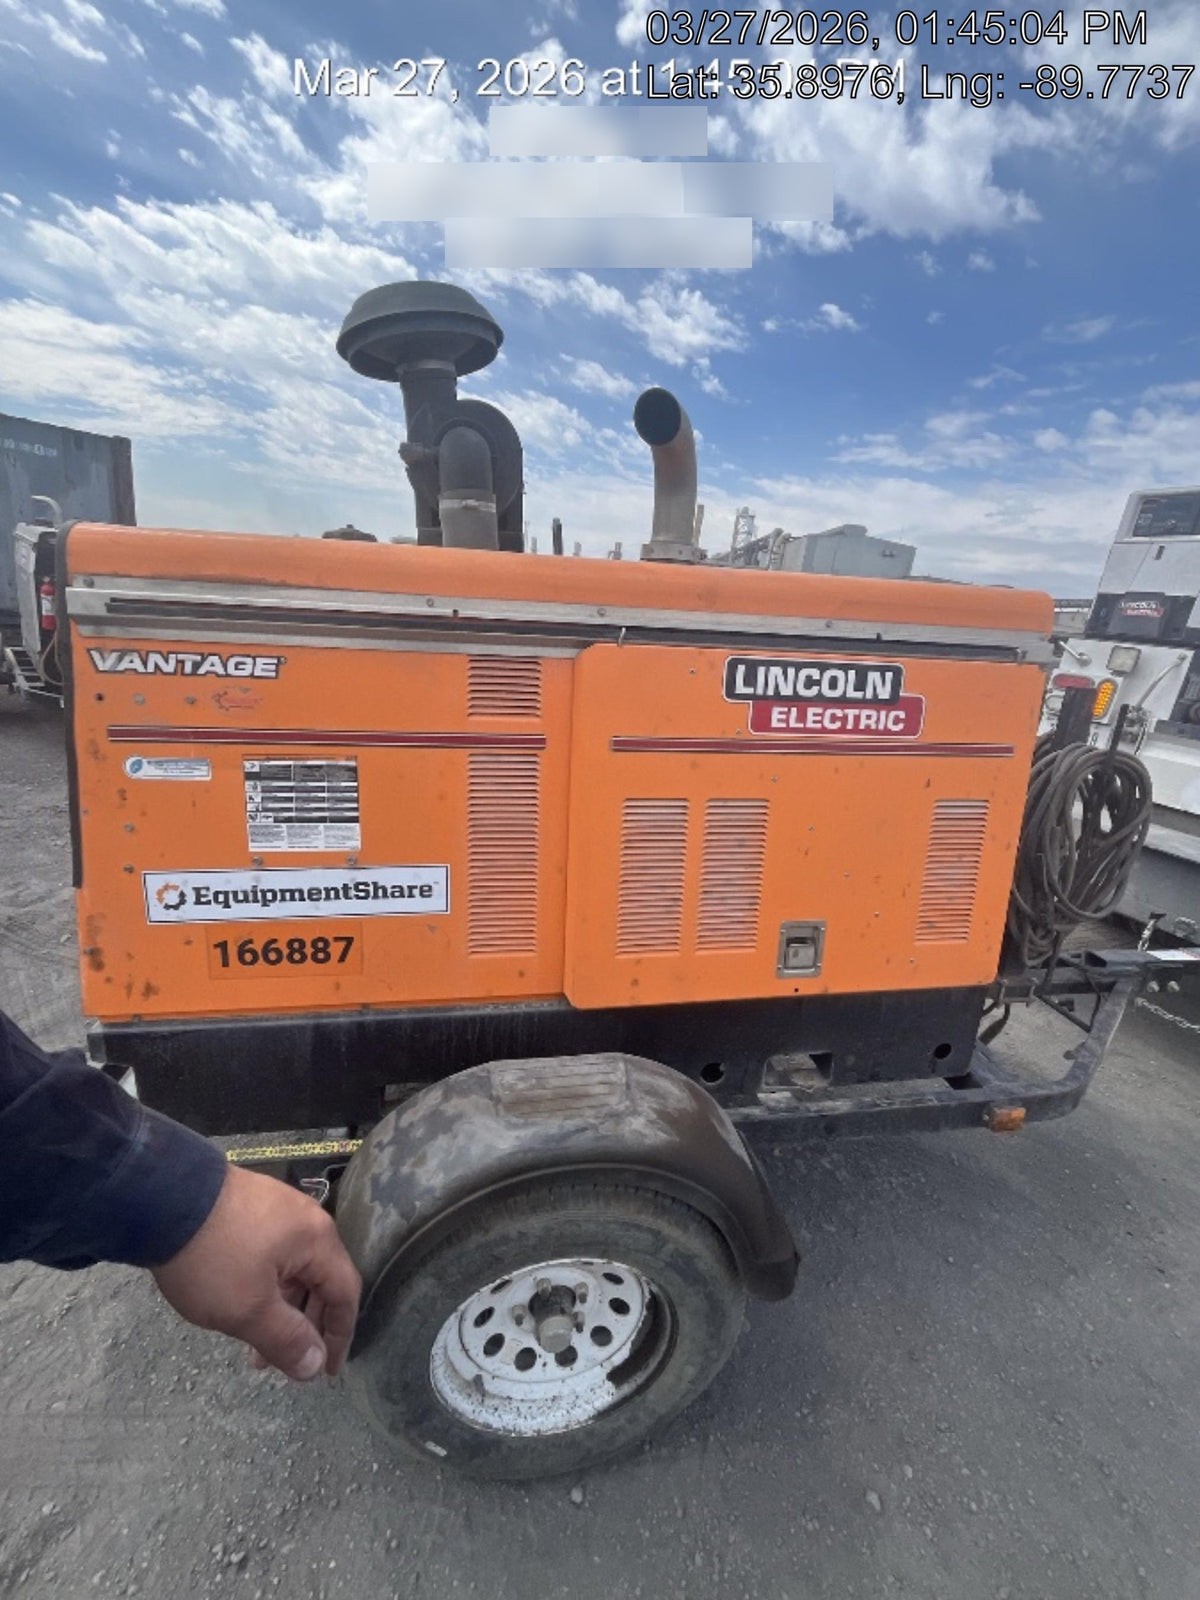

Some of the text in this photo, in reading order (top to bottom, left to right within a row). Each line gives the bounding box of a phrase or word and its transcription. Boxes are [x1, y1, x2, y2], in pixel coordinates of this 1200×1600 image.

[89, 650, 279, 678] VANTAGE
[735, 664, 893, 700] LINCOLN
[770, 706, 907, 732] ELECTRIC
[192, 880, 434, 909] EquipmentShare
[212, 936, 355, 967] 166887
